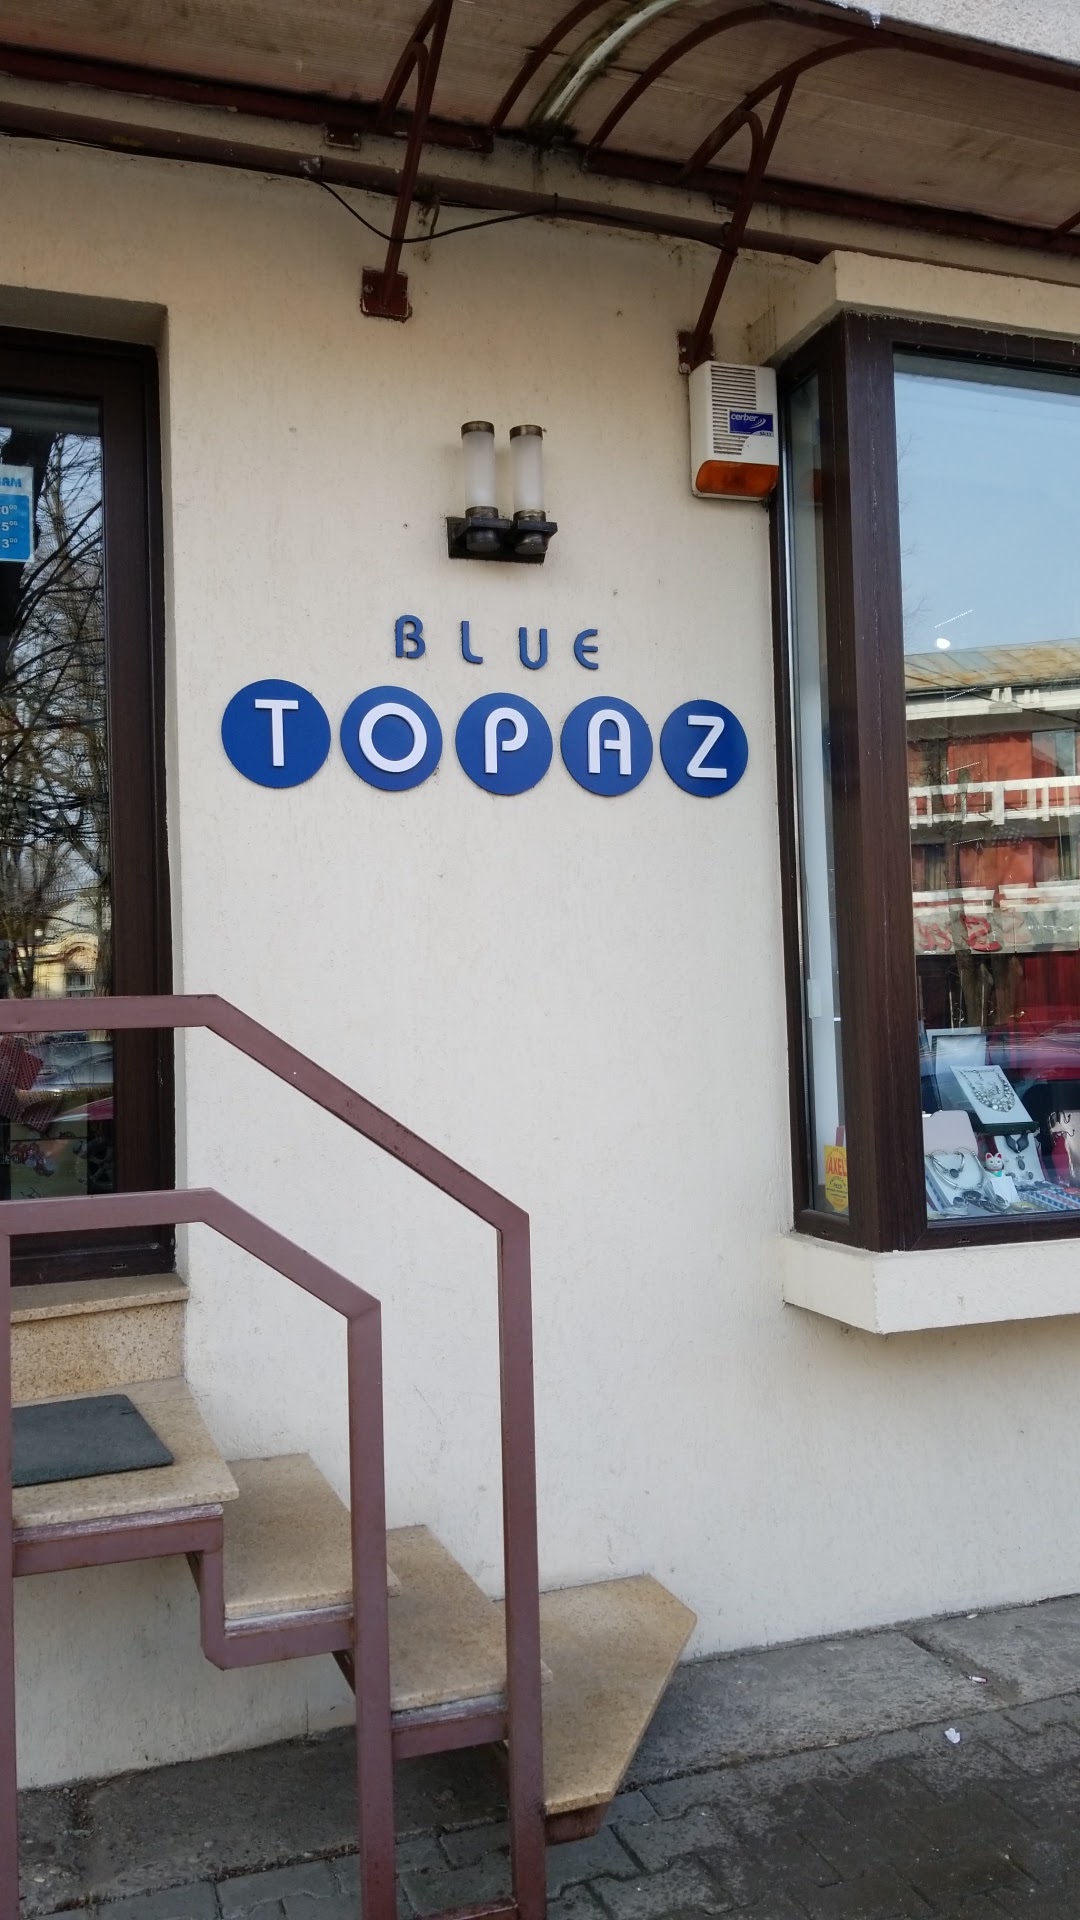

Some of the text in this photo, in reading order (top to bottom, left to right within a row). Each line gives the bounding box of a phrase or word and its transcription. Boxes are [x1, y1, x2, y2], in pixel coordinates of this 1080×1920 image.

[731, 413, 758, 422] cerber
[395, 614, 599, 670] BLUE
[255, 698, 728, 780] TOPAZ
